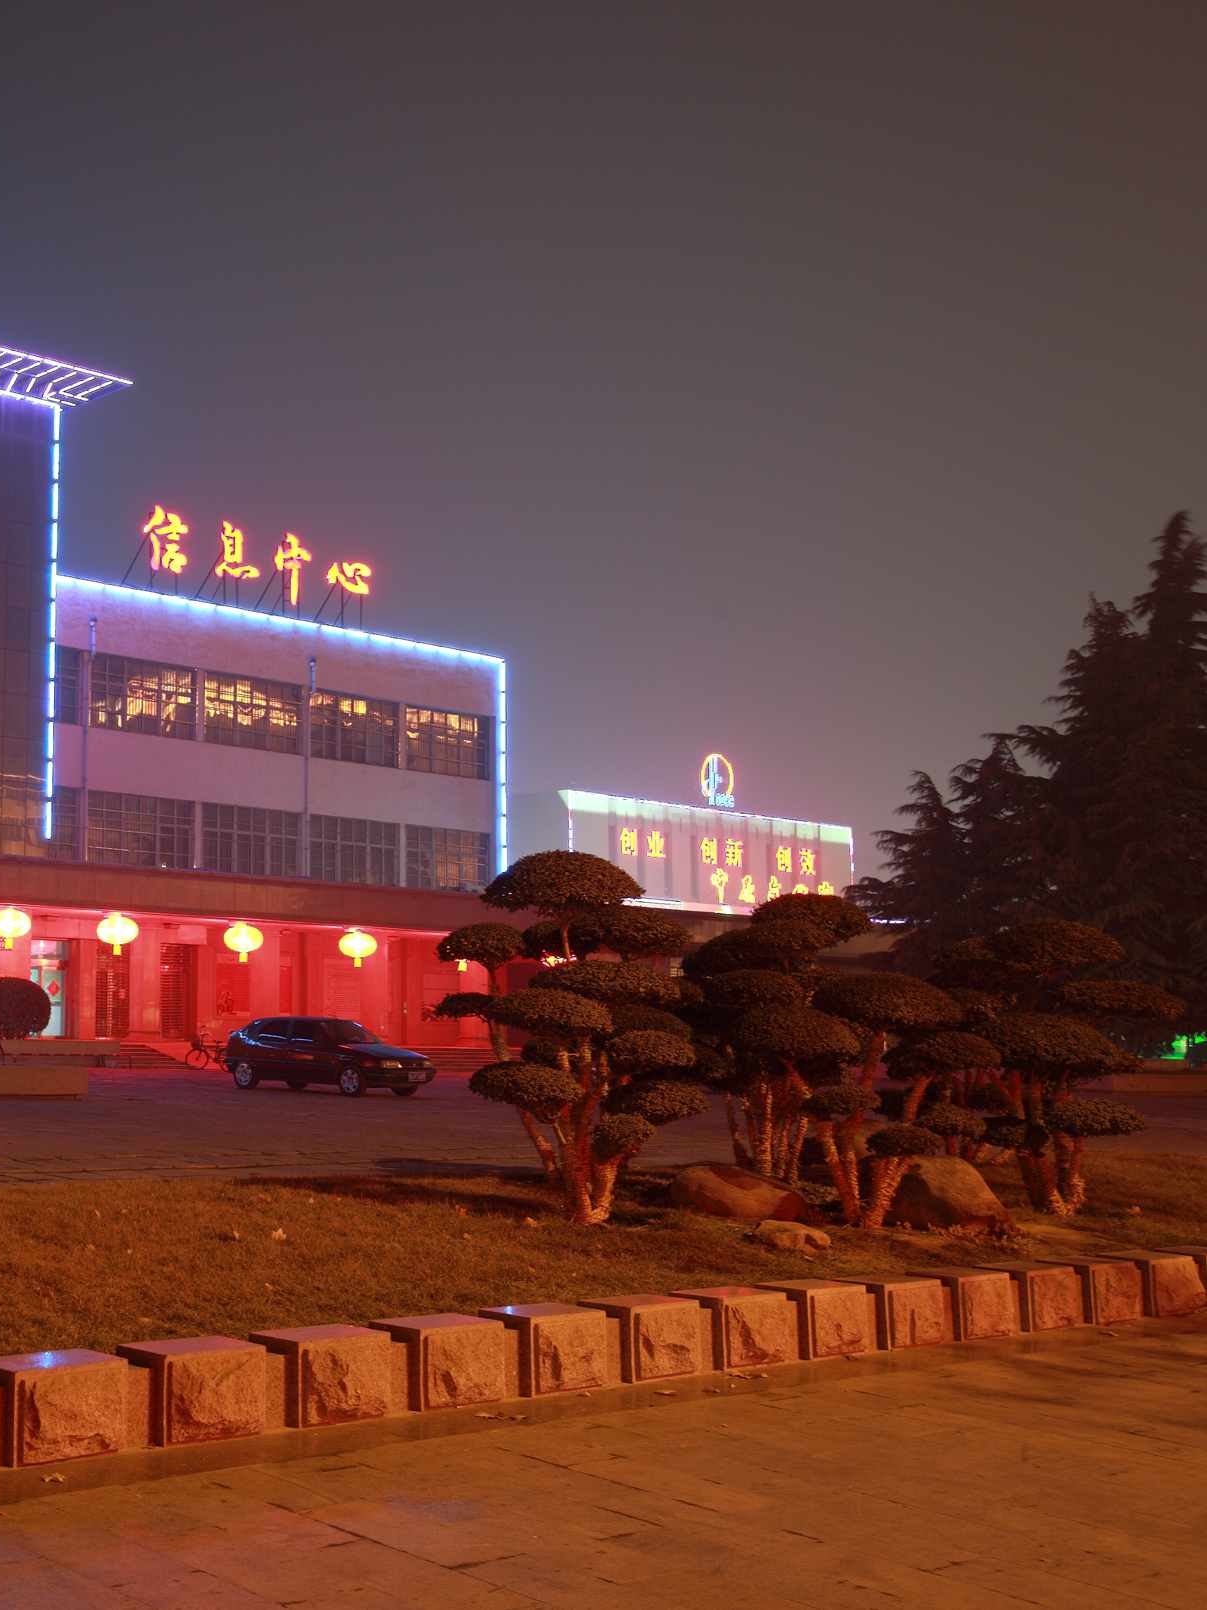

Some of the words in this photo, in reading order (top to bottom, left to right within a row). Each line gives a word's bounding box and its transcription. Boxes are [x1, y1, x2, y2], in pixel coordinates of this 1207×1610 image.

[143, 505, 372, 605] 信息中心
[620, 827, 666, 858] 创业
[700, 837, 743, 867] 创新
